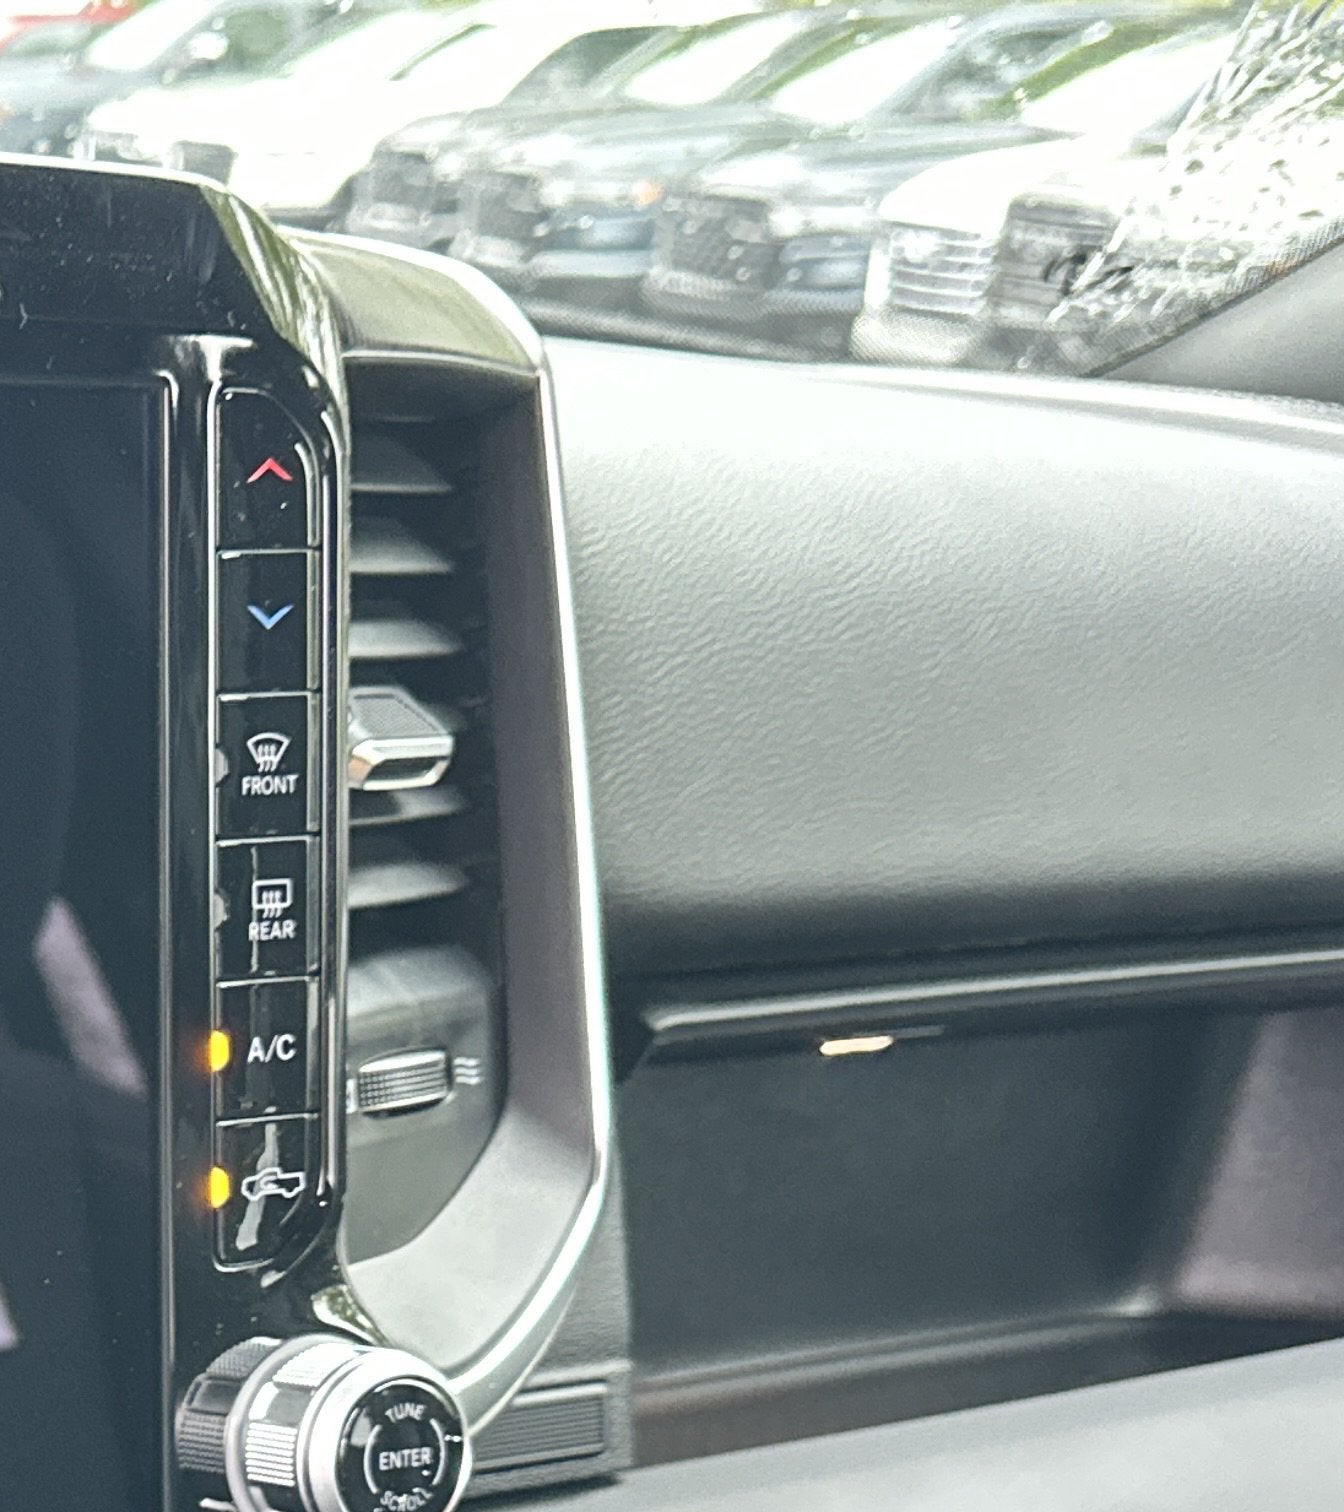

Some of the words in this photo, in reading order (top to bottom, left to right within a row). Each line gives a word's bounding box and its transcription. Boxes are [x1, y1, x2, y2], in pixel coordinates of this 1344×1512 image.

[242, 774, 299, 796] FRONT
[248, 919, 297, 941] REAR
[248, 1035, 297, 1063] A/C
[385, 1402, 426, 1423] TUNE
[379, 1447, 433, 1471] ENTER
